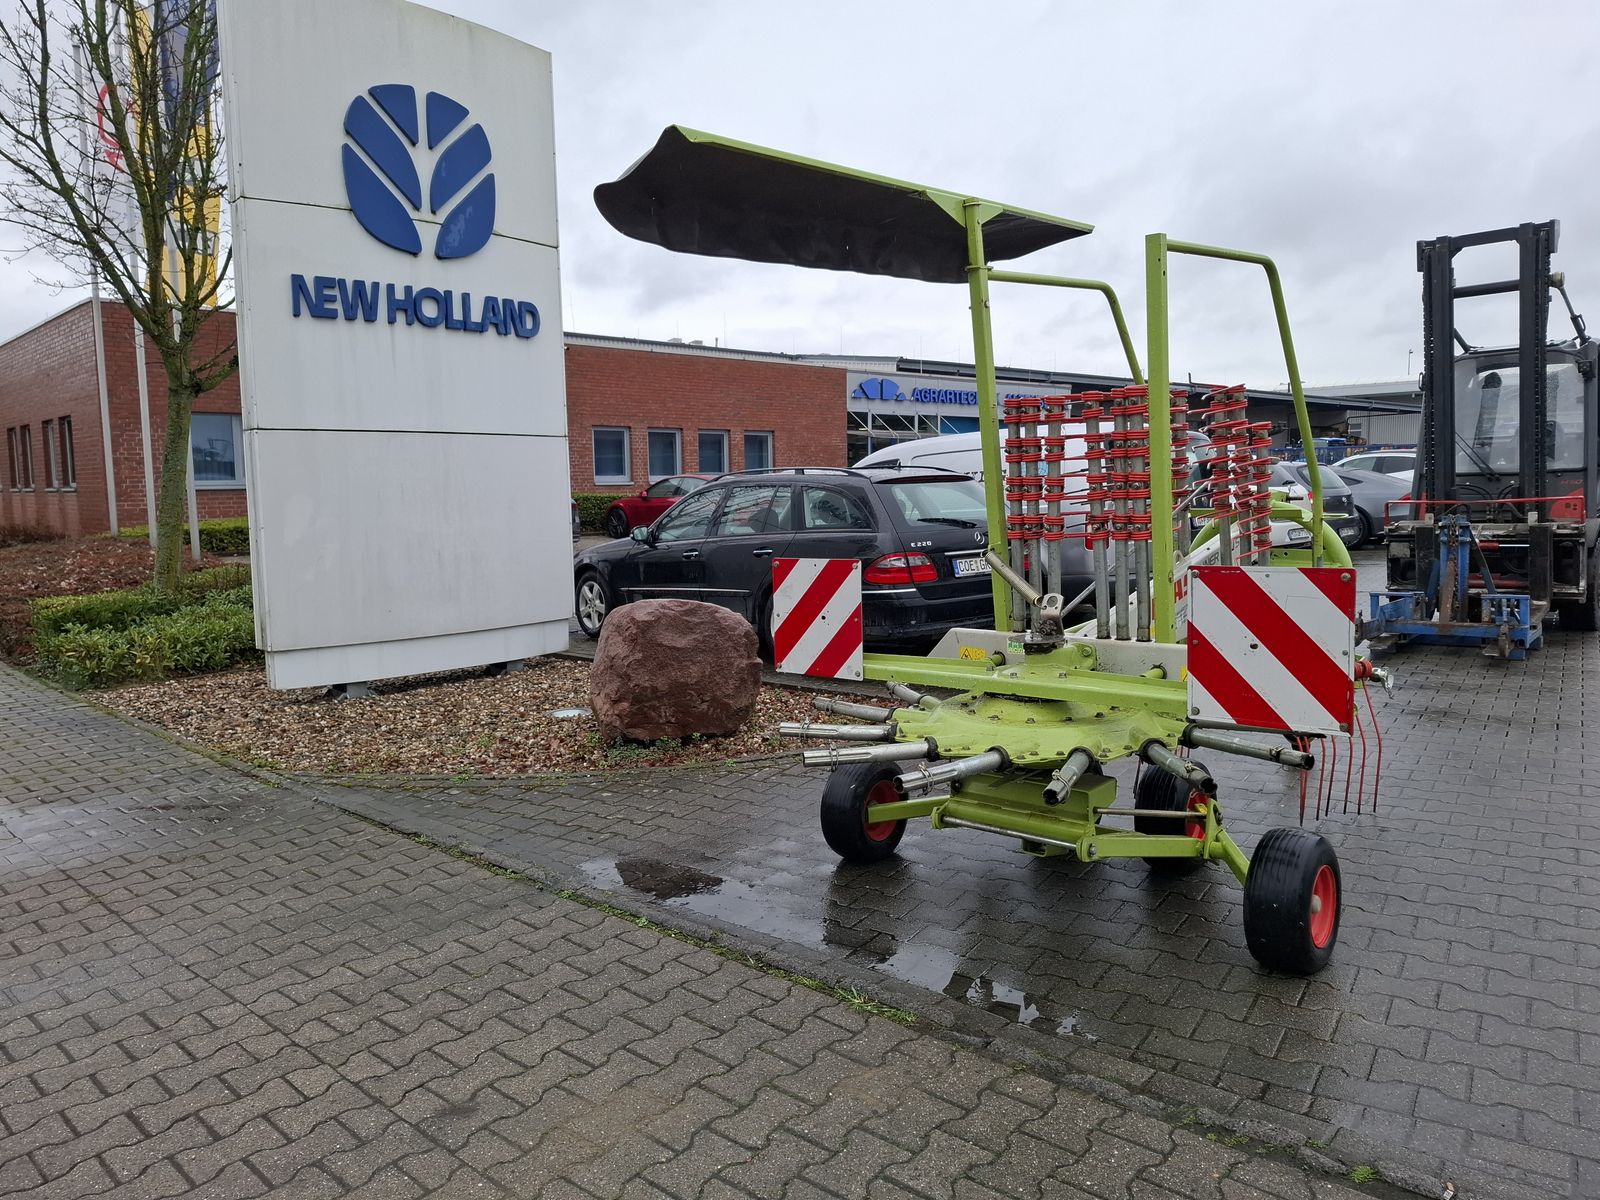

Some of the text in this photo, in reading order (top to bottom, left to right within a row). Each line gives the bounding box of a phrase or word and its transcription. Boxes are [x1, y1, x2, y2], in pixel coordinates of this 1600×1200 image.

[290, 273, 541, 339] NEW HOLLAND
[911, 387, 978, 405] AGRARTEC
[958, 560, 976, 573] COE
